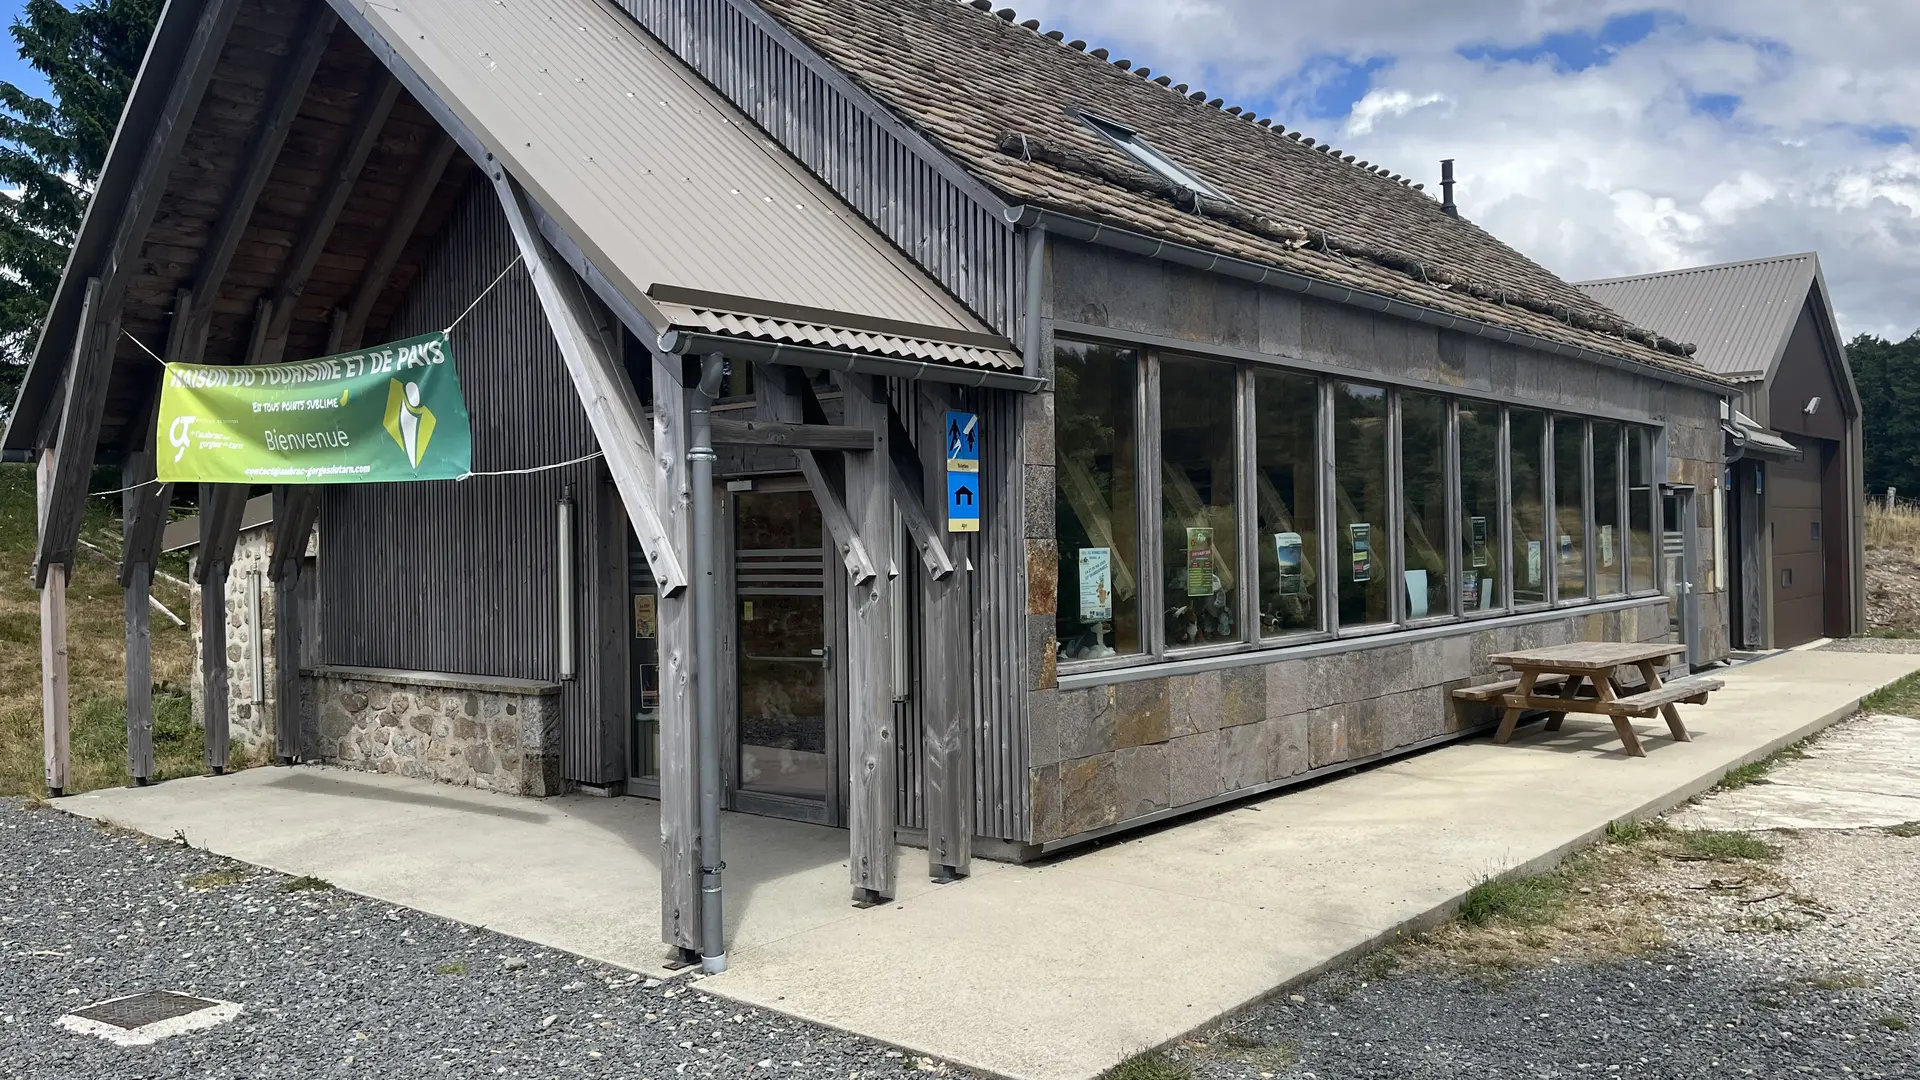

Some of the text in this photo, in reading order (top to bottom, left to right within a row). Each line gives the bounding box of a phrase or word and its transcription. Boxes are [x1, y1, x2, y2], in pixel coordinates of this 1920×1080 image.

[170, 340, 445, 388] MAISON DU TOURISME ET DE PAYS
[263, 402, 280, 412] TOUS
[282, 399, 305, 411] POINTS
[306, 397, 339, 410] SUBLIME
[265, 429, 350, 451] Bienvenue
[244, 465, 371, 477] contact@aubrac-gorgesdutarn.com
